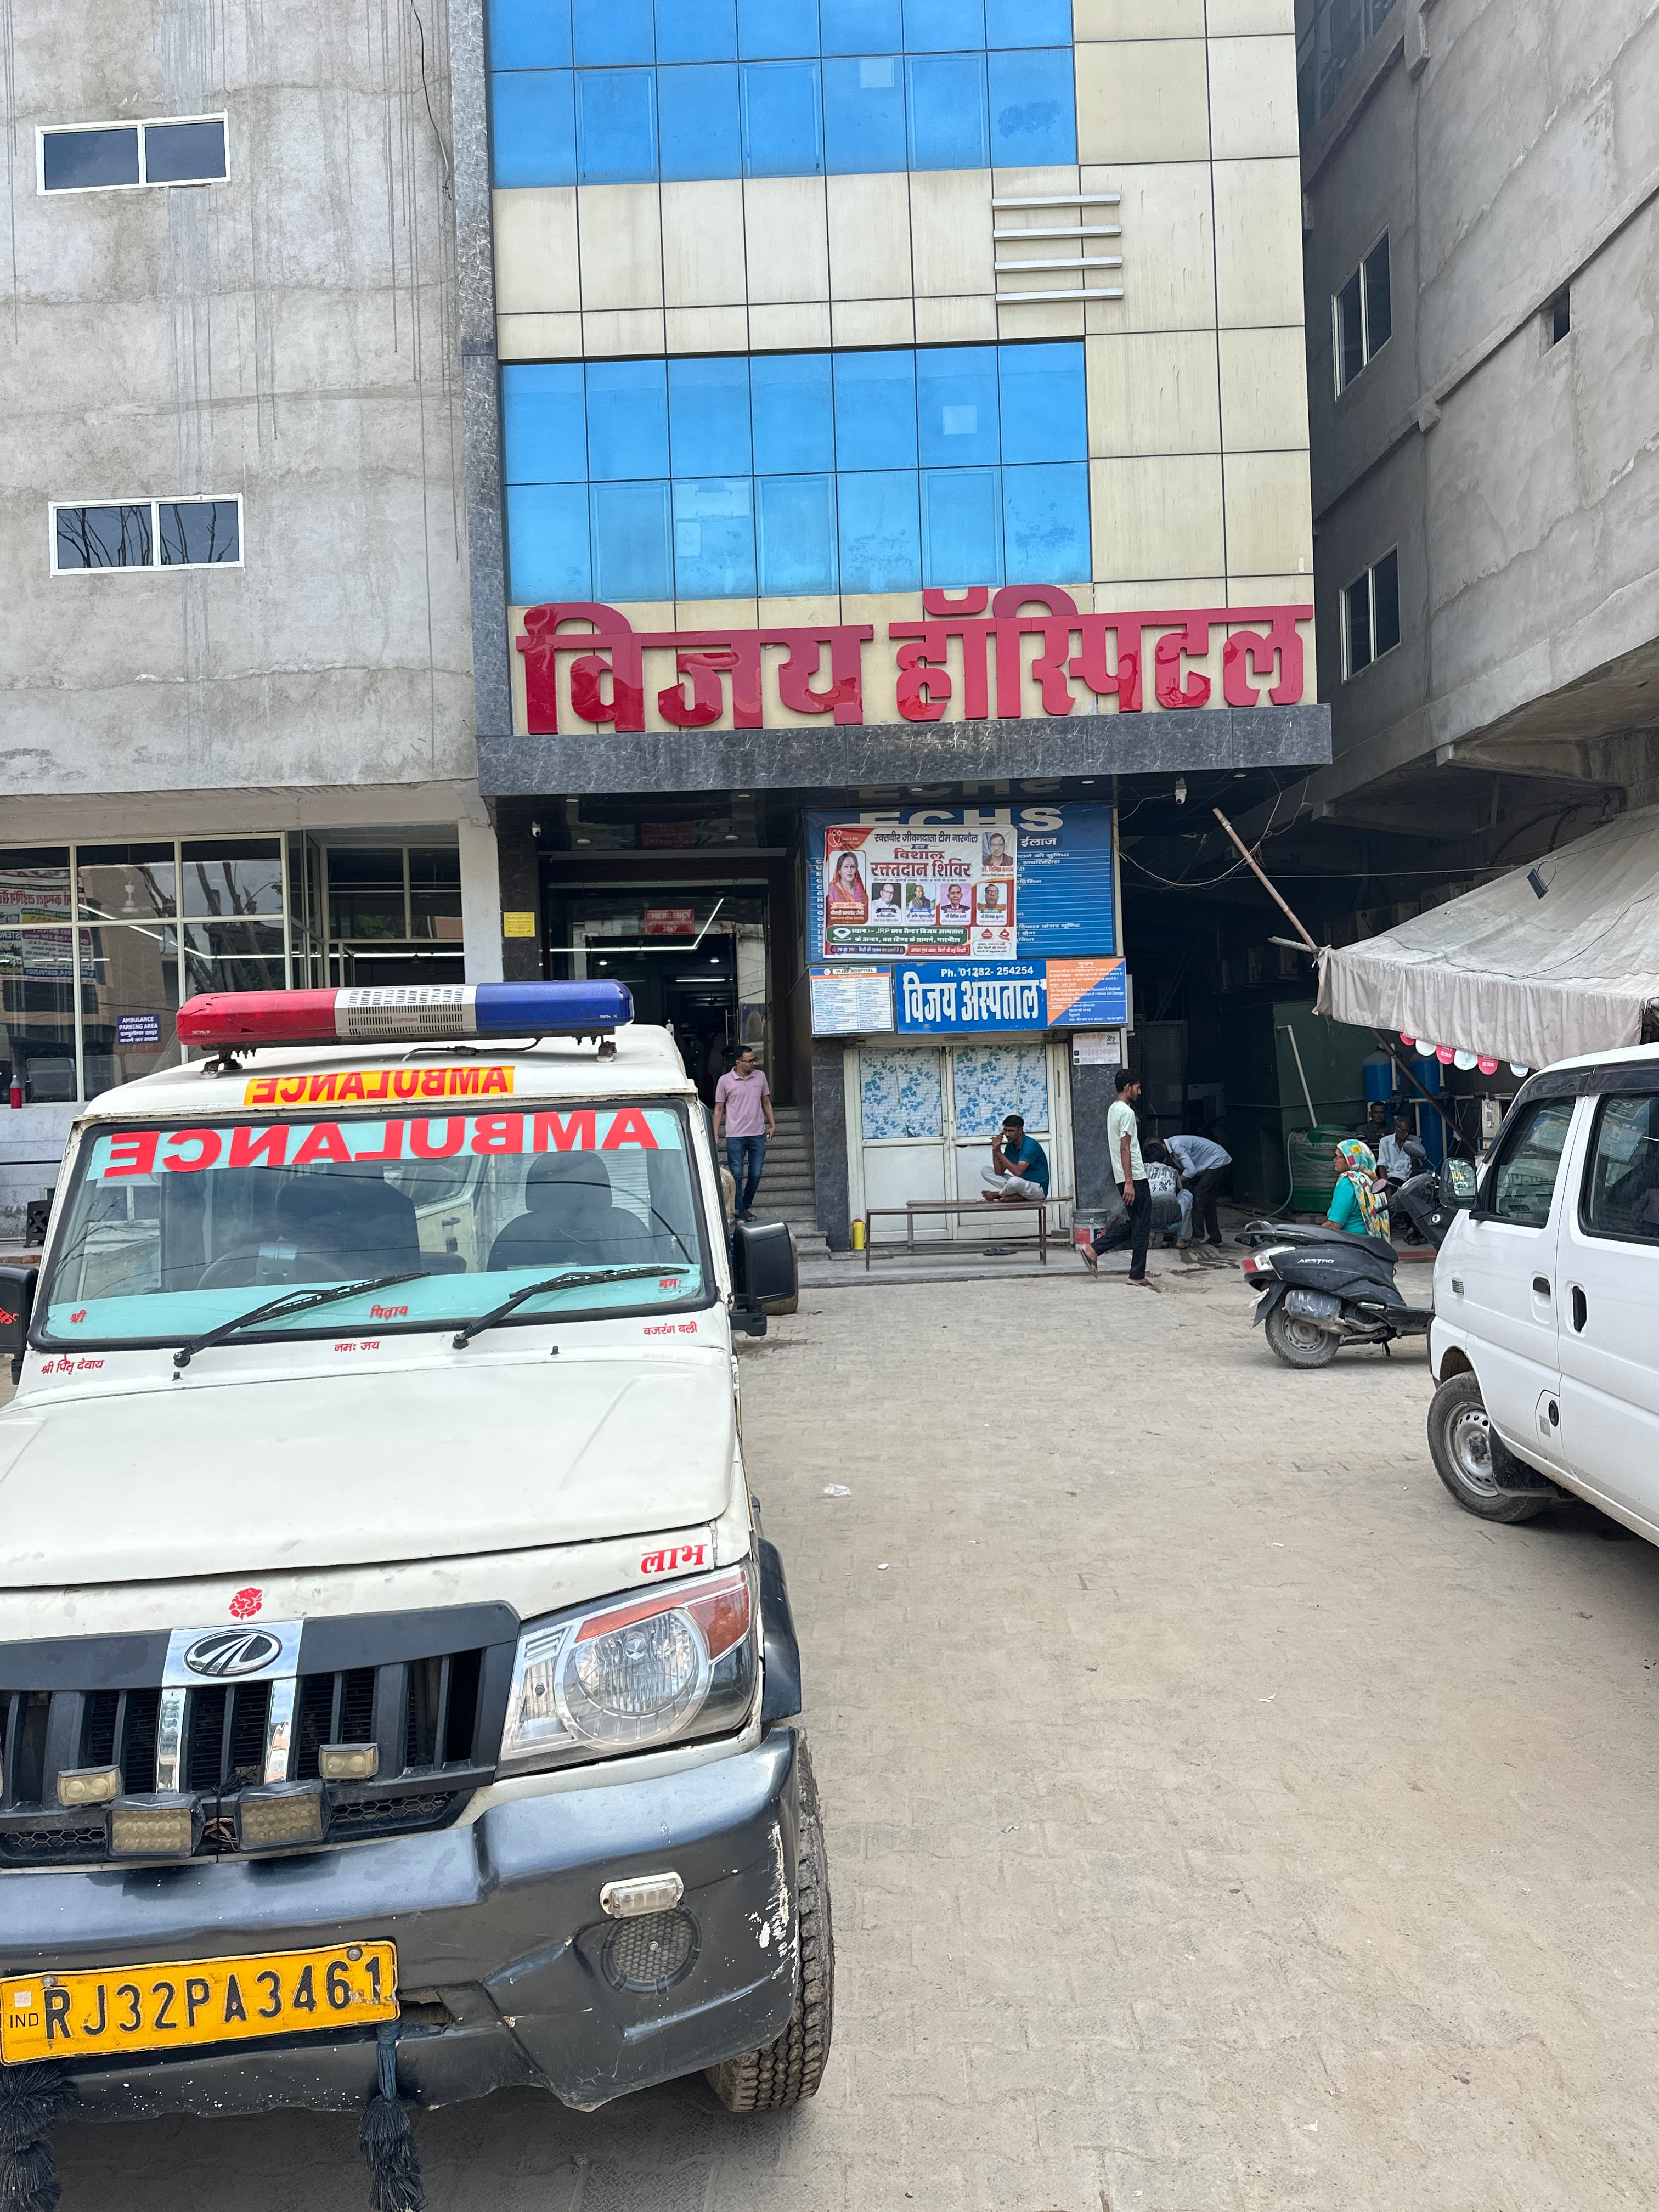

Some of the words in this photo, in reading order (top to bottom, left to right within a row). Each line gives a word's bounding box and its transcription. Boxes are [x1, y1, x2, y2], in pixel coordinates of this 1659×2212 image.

[516, 603, 874, 734] विजय
[888, 585, 1313, 721] हॉस्पिटल
[902, 831, 936, 843] जीवनदाता
[938, 831, 950, 843] टीम
[952, 831, 978, 843] नारनौल
[1020, 836, 1057, 847] ईलाज
[894, 848, 945, 859] विशाल
[870, 862, 929, 877] रक्तदान
[932, 858, 972, 877] शिविर
[941, 969, 957, 977] Ph.
[997, 966, 1034, 975] 254254
[902, 971, 957, 1023] विजय
[961, 979, 1040, 1021] अस्पताल
[360, 1341, 380, 1350] जय
[42, 1361, 54, 1374] श्री
[77, 1358, 105, 1370] देवाय
[641, 1544, 708, 1574] लाभ
[43, 1956, 382, 2040] RJ32PA3461
[10, 2013, 39, 2028] IND
